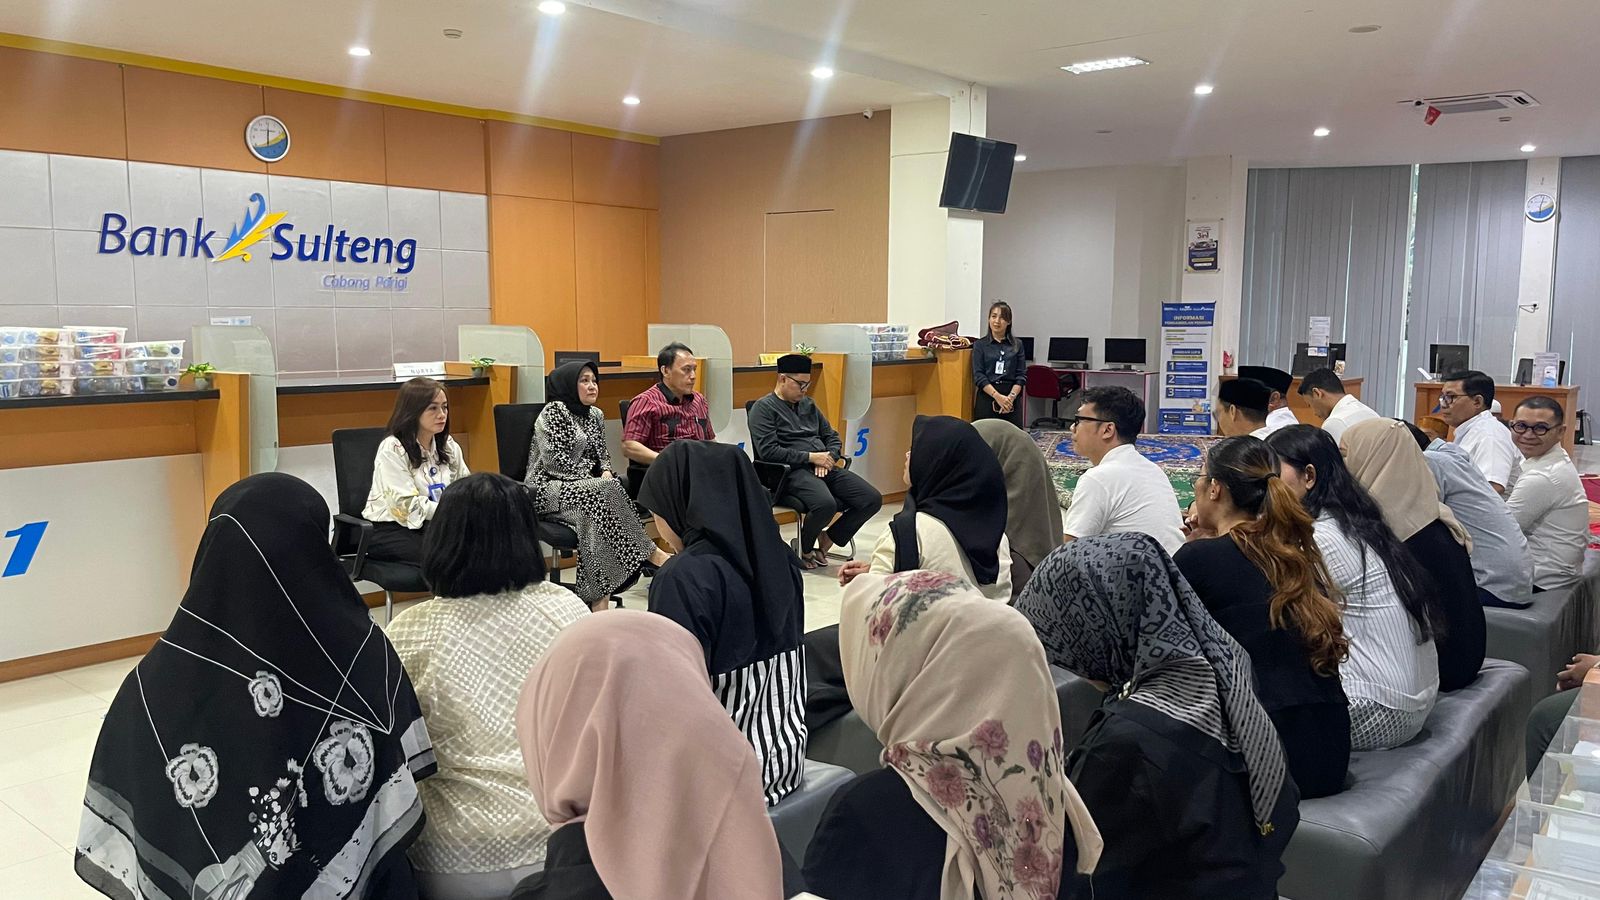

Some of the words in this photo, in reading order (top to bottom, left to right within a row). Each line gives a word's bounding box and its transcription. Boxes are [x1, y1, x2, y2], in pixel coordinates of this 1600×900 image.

[97, 213, 217, 259] Bank
[270, 223, 417, 274] Sulteng
[323, 274, 370, 291] Cabang
[375, 275, 408, 291] Parigi
[1169, 361, 1175, 370] 1
[1168, 374, 1176, 383] 2
[1167, 387, 1175, 397] 3
[853, 427, 870, 457] 5
[2, 520, 49, 578] 1
